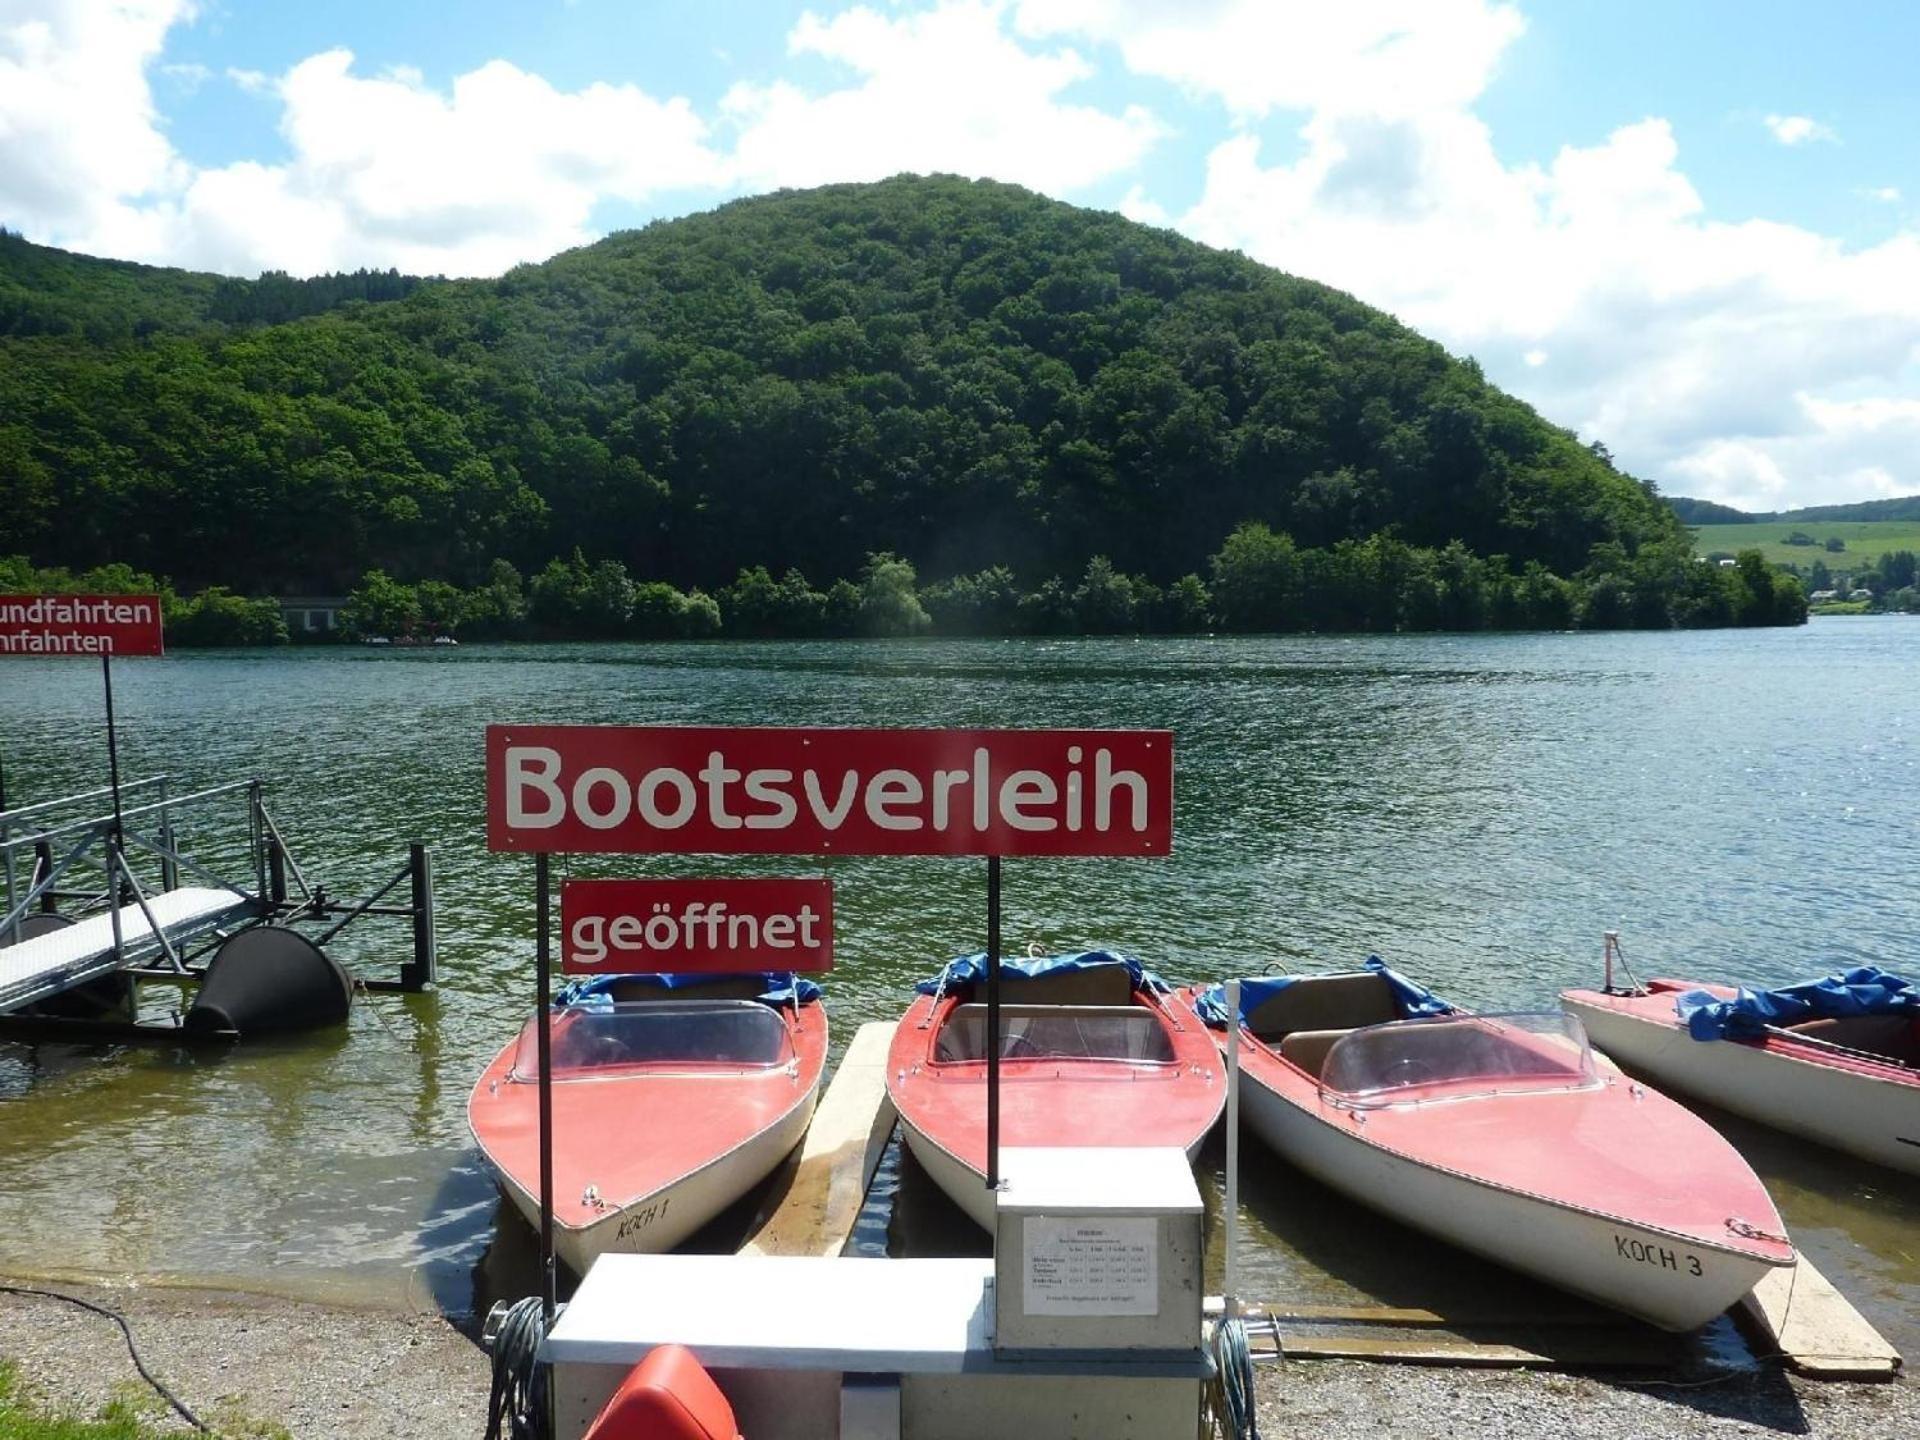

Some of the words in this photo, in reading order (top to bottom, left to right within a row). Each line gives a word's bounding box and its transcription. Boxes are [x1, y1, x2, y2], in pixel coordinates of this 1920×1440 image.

[505, 746, 1148, 832] Bootsverleih
[571, 902, 821, 964] geöffnet
[1614, 1234, 1678, 1271] KOCH
[1686, 1254, 1704, 1277] 3
